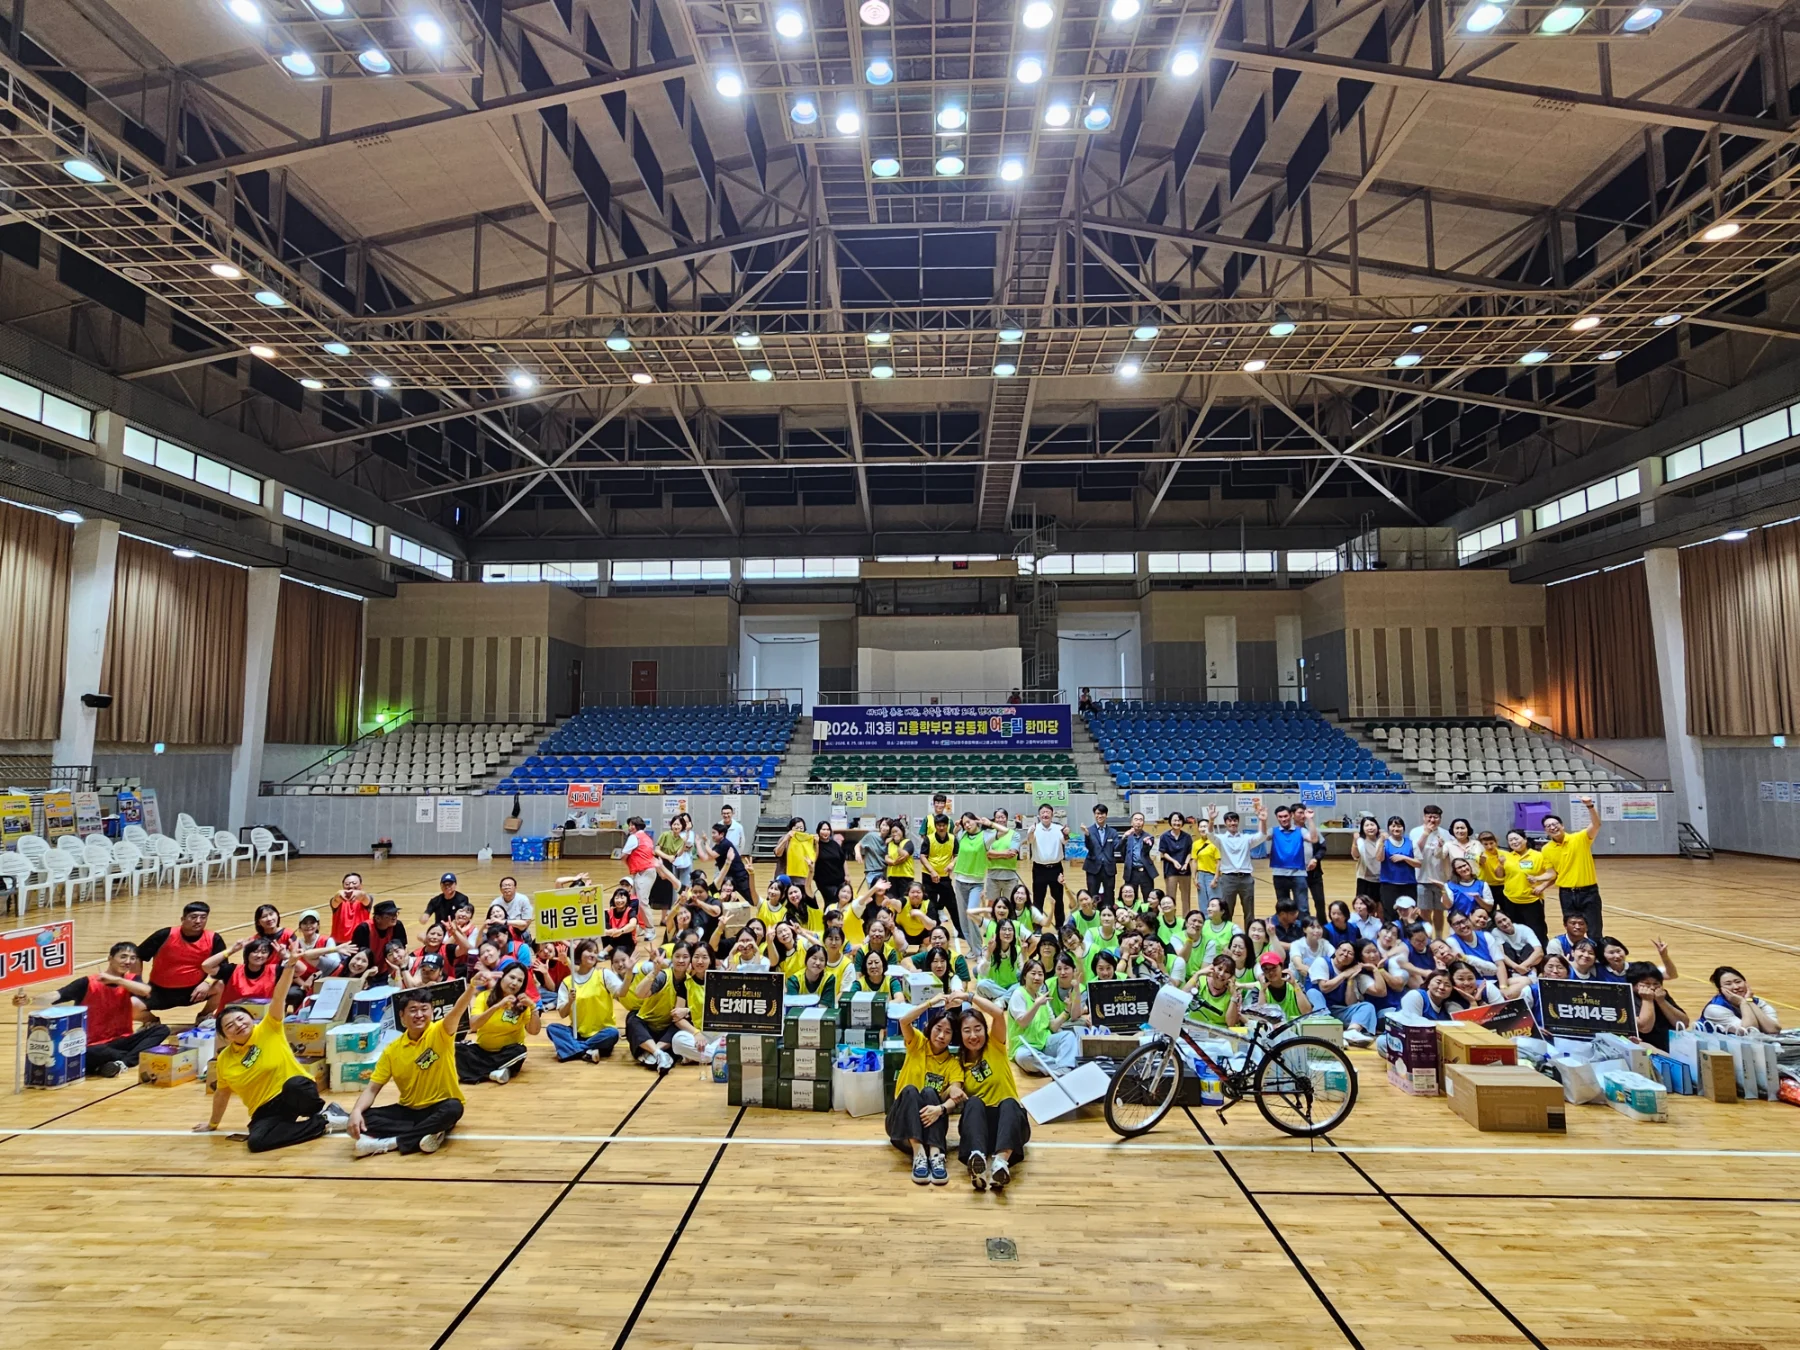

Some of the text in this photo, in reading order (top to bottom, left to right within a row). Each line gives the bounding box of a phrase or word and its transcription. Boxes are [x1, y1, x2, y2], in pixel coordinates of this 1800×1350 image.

[826, 716, 1059, 738] 2026. 제3회 고흥학부모 공동체 어울림 한마당
[834, 791, 864, 802] 배움팀
[1036, 790, 1066, 801] 우주팀
[541, 904, 598, 929] 배움팀
[720, 998, 767, 1015] 단체1등
[1103, 1001, 1149, 1017] 단체3등
[1557, 1003, 1618, 1022] 단체4등
